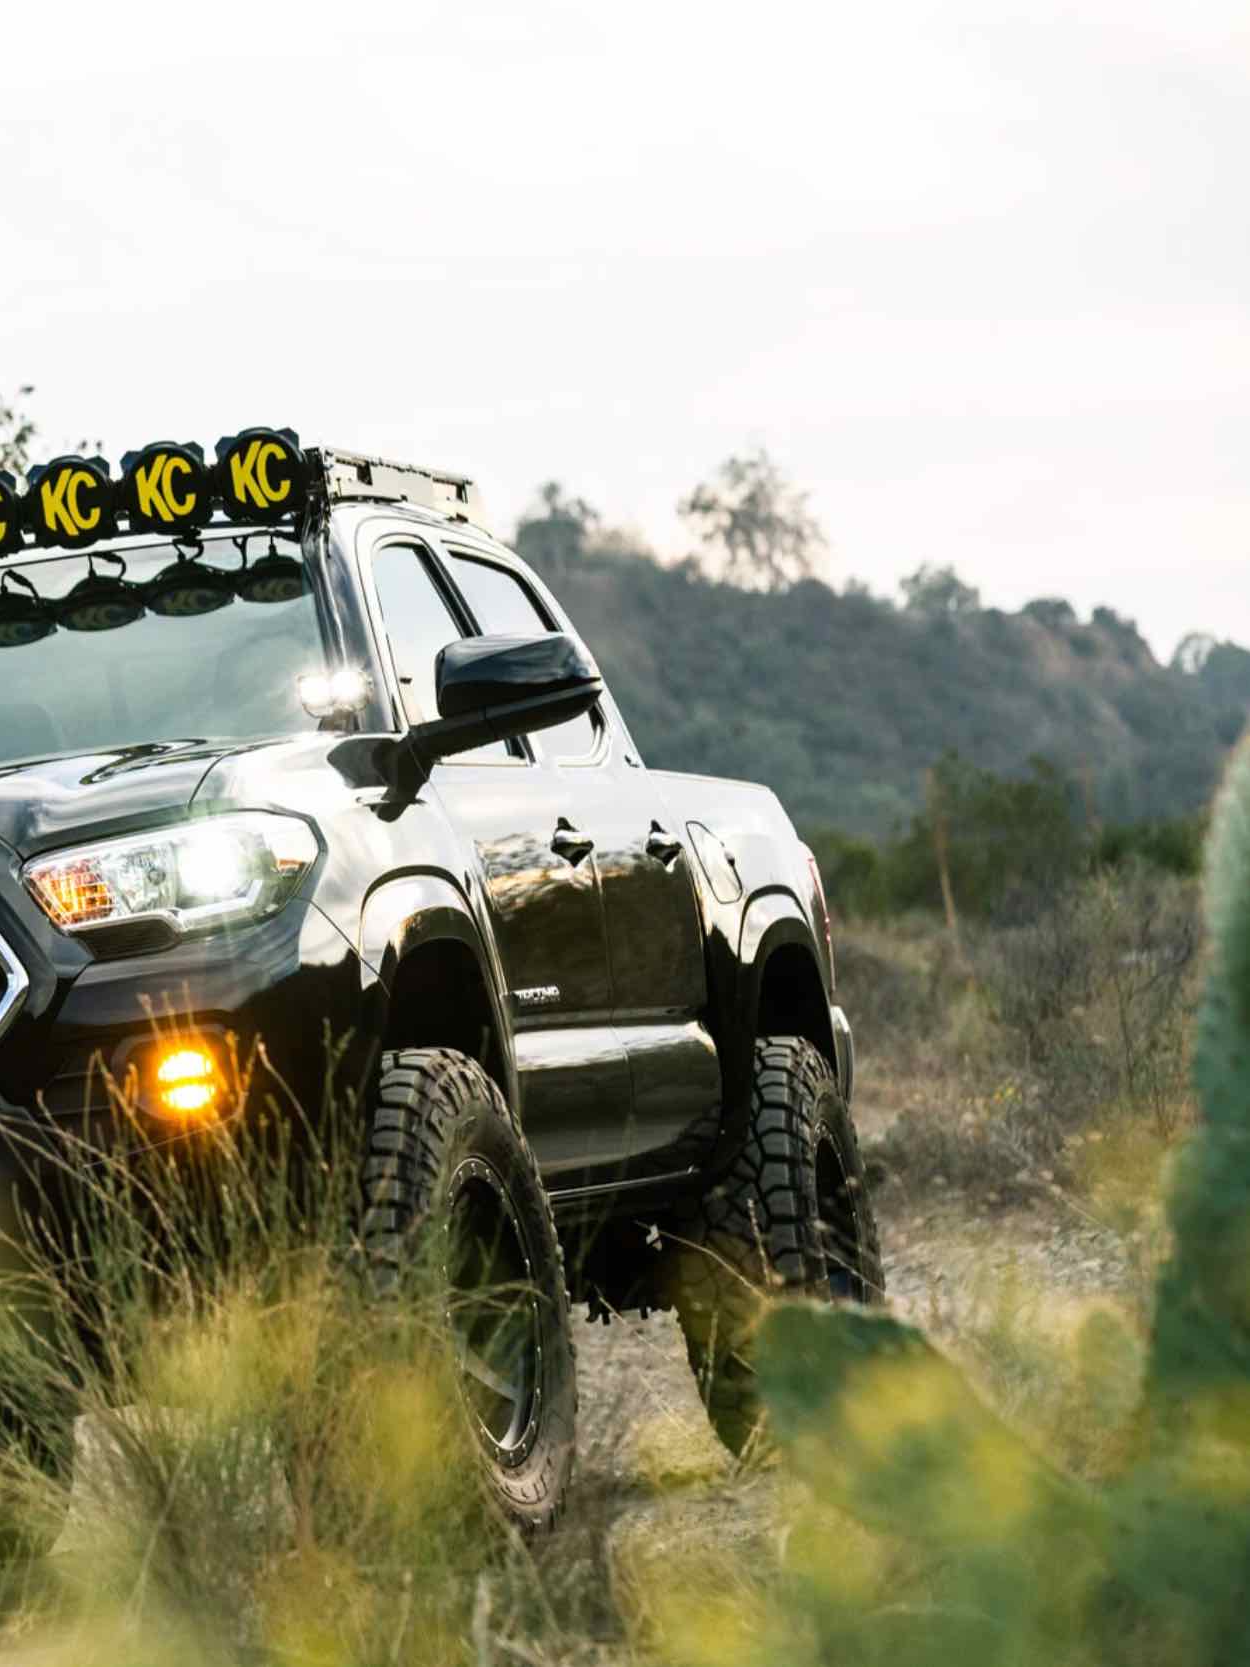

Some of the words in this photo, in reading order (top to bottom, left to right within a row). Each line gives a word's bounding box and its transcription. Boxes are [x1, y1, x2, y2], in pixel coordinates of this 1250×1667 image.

[41, 469, 101, 536] KC
[135, 455, 196, 522] KC
[230, 441, 291, 508] KC
